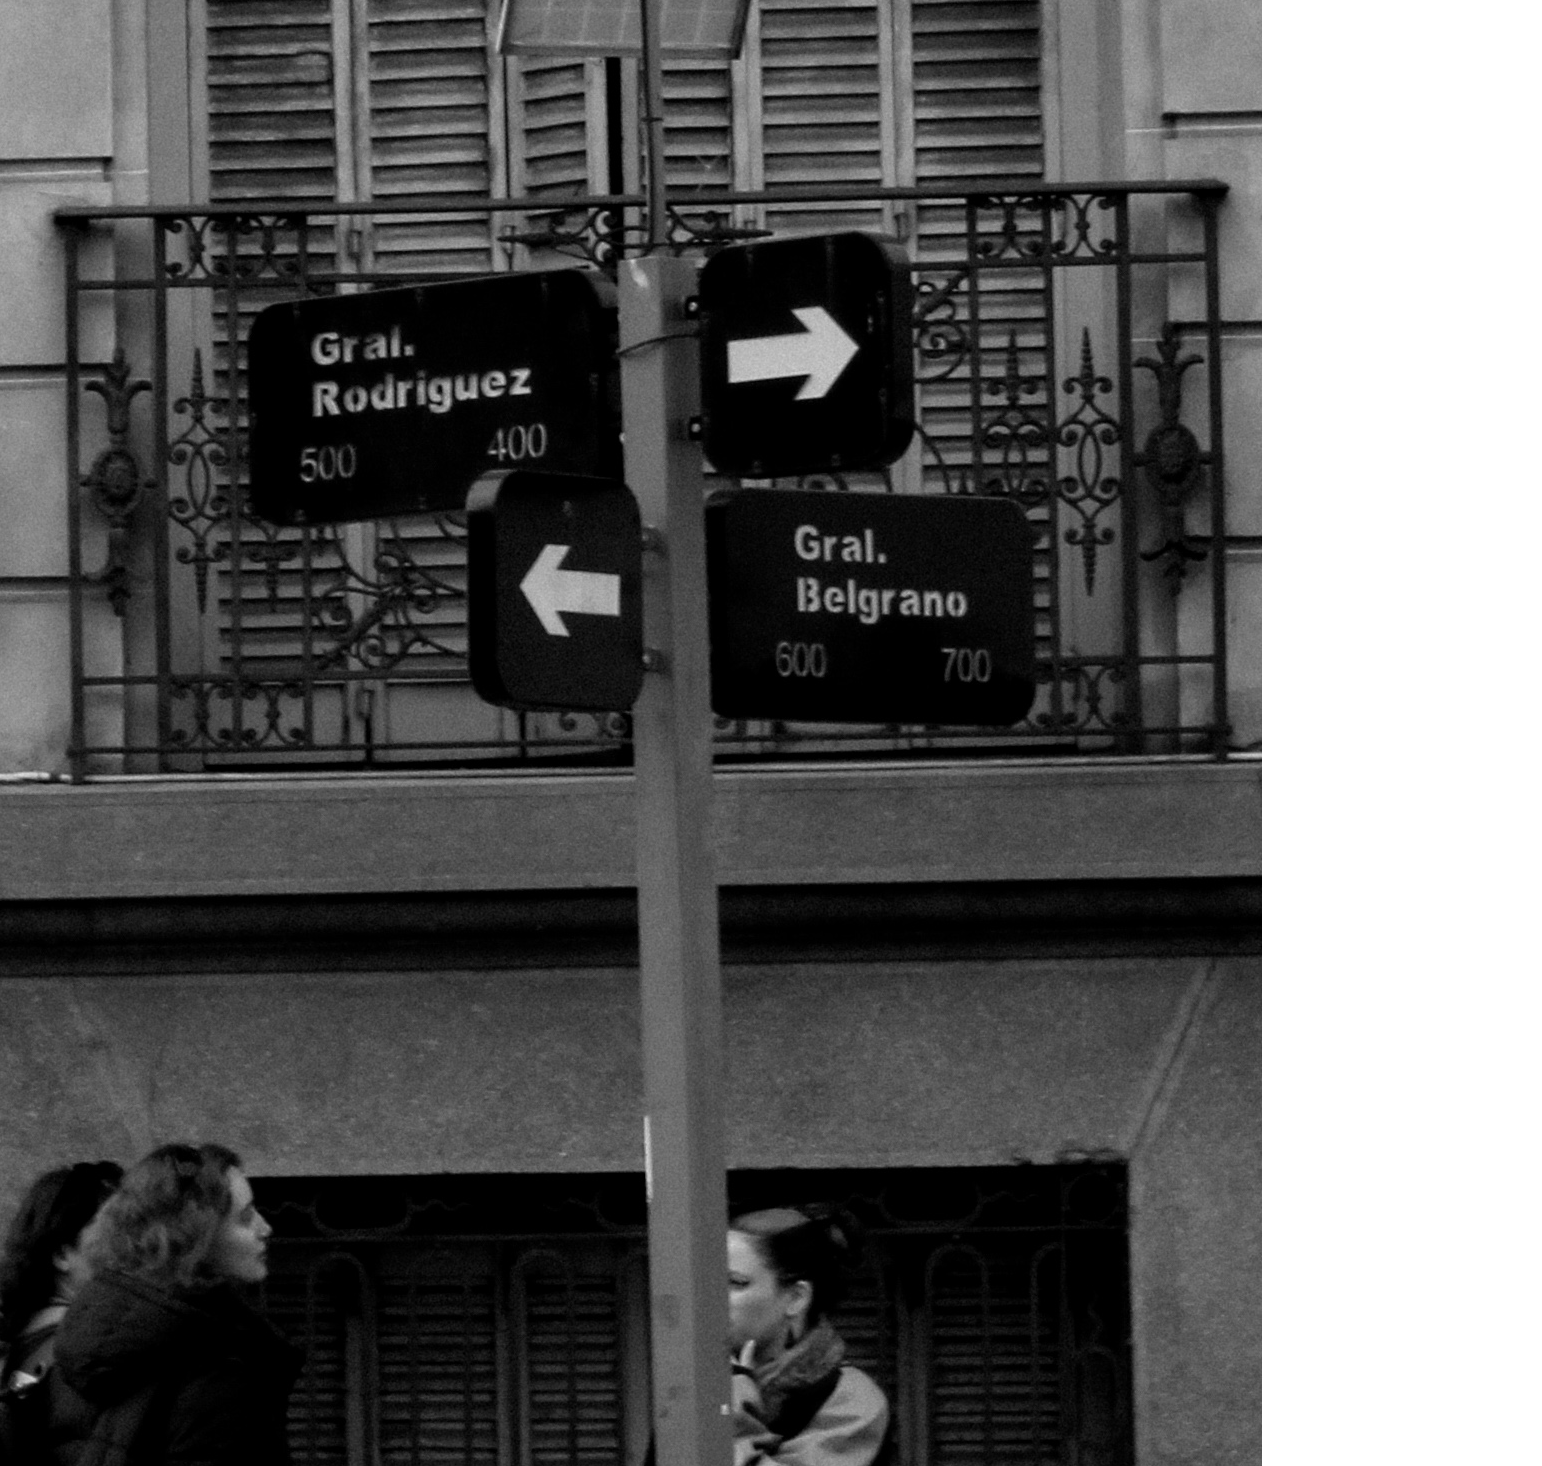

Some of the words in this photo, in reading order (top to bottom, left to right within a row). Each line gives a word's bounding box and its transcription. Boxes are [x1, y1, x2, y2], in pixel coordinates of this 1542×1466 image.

[310, 324, 415, 366] Gral.
[299, 443, 357, 483] 500
[487, 422, 548, 462] 400
[794, 524, 887, 564] Gral.
[796, 577, 969, 625] Belgrano
[775, 641, 826, 678] 600
[940, 647, 992, 683] 700
